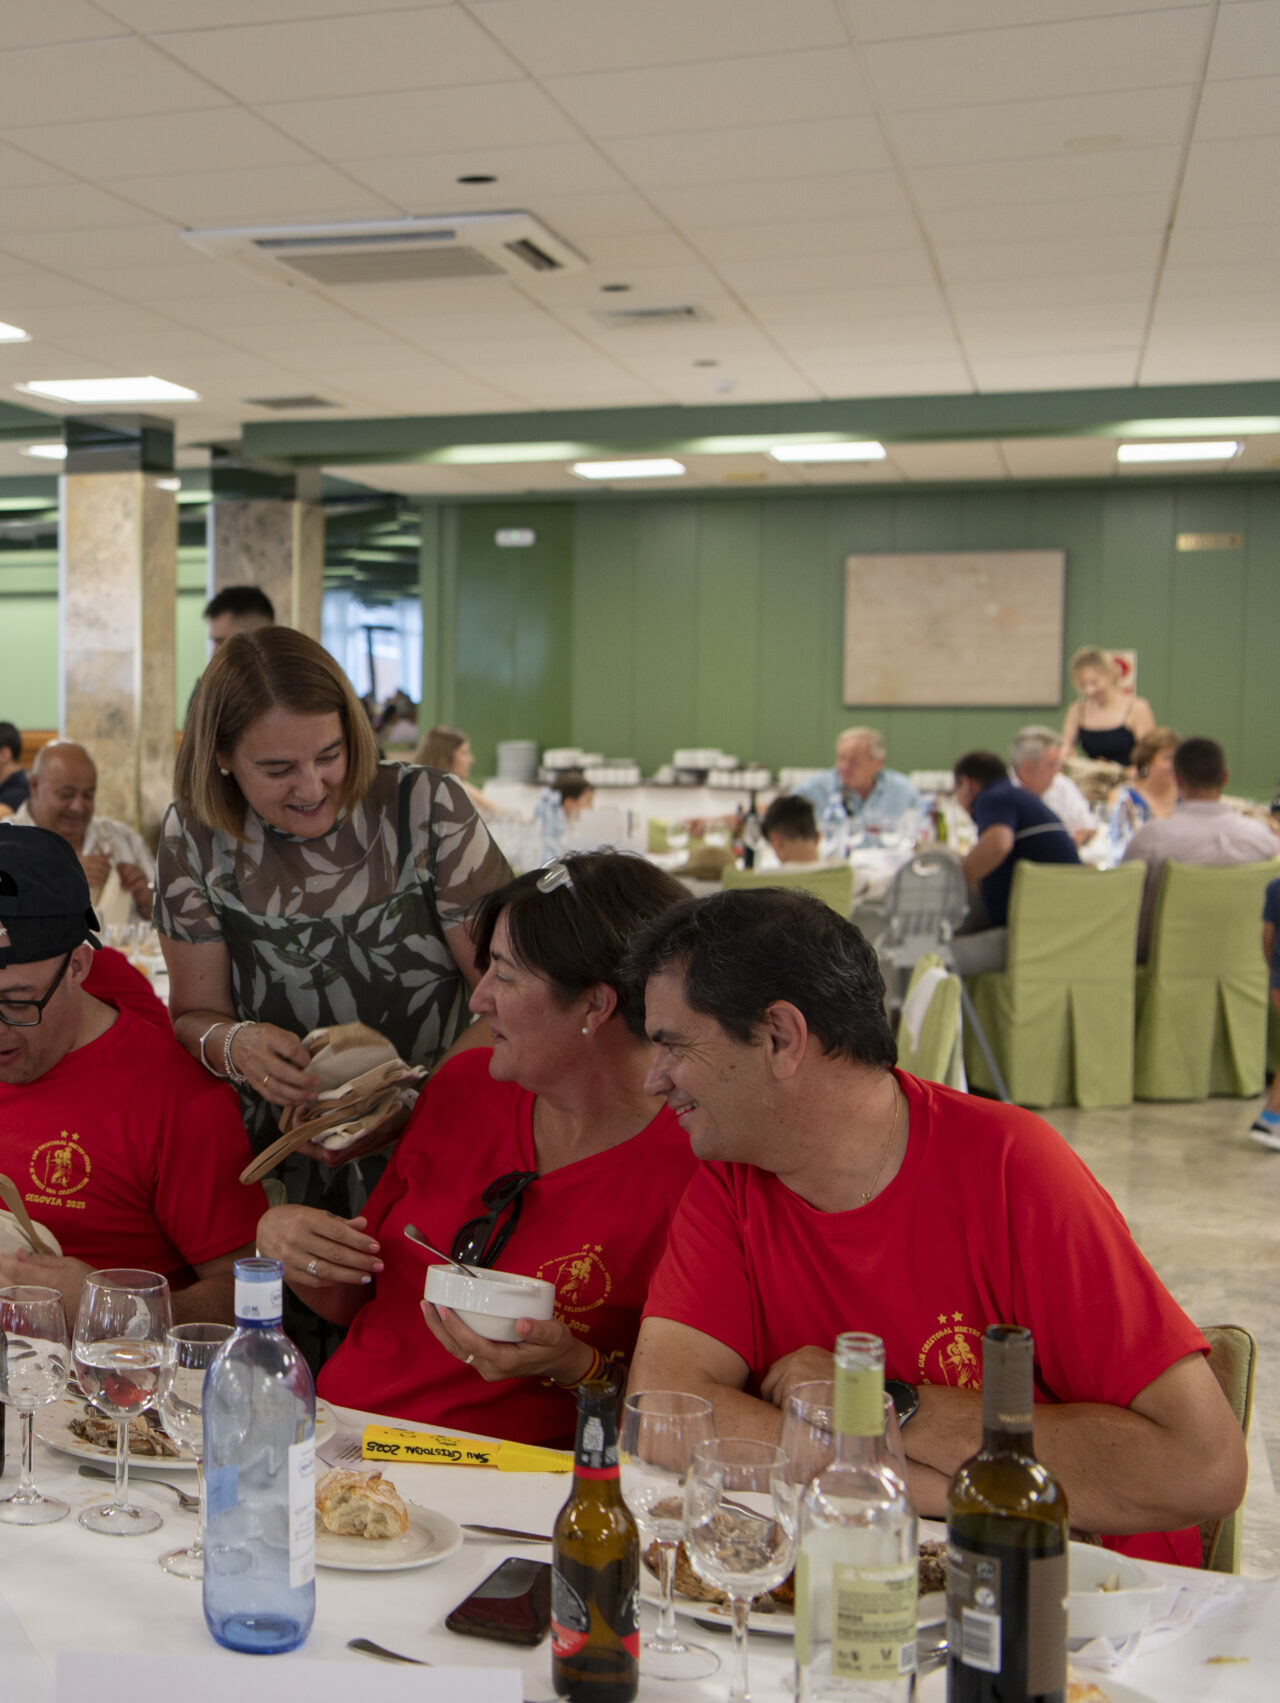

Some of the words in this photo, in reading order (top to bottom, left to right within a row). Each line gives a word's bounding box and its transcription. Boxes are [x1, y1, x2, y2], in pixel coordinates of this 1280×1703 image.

[25, 1193, 63, 1206] SEGOVIA
[65, 1199, 87, 1210] 2025
[366, 1441, 401, 1456] 2025
